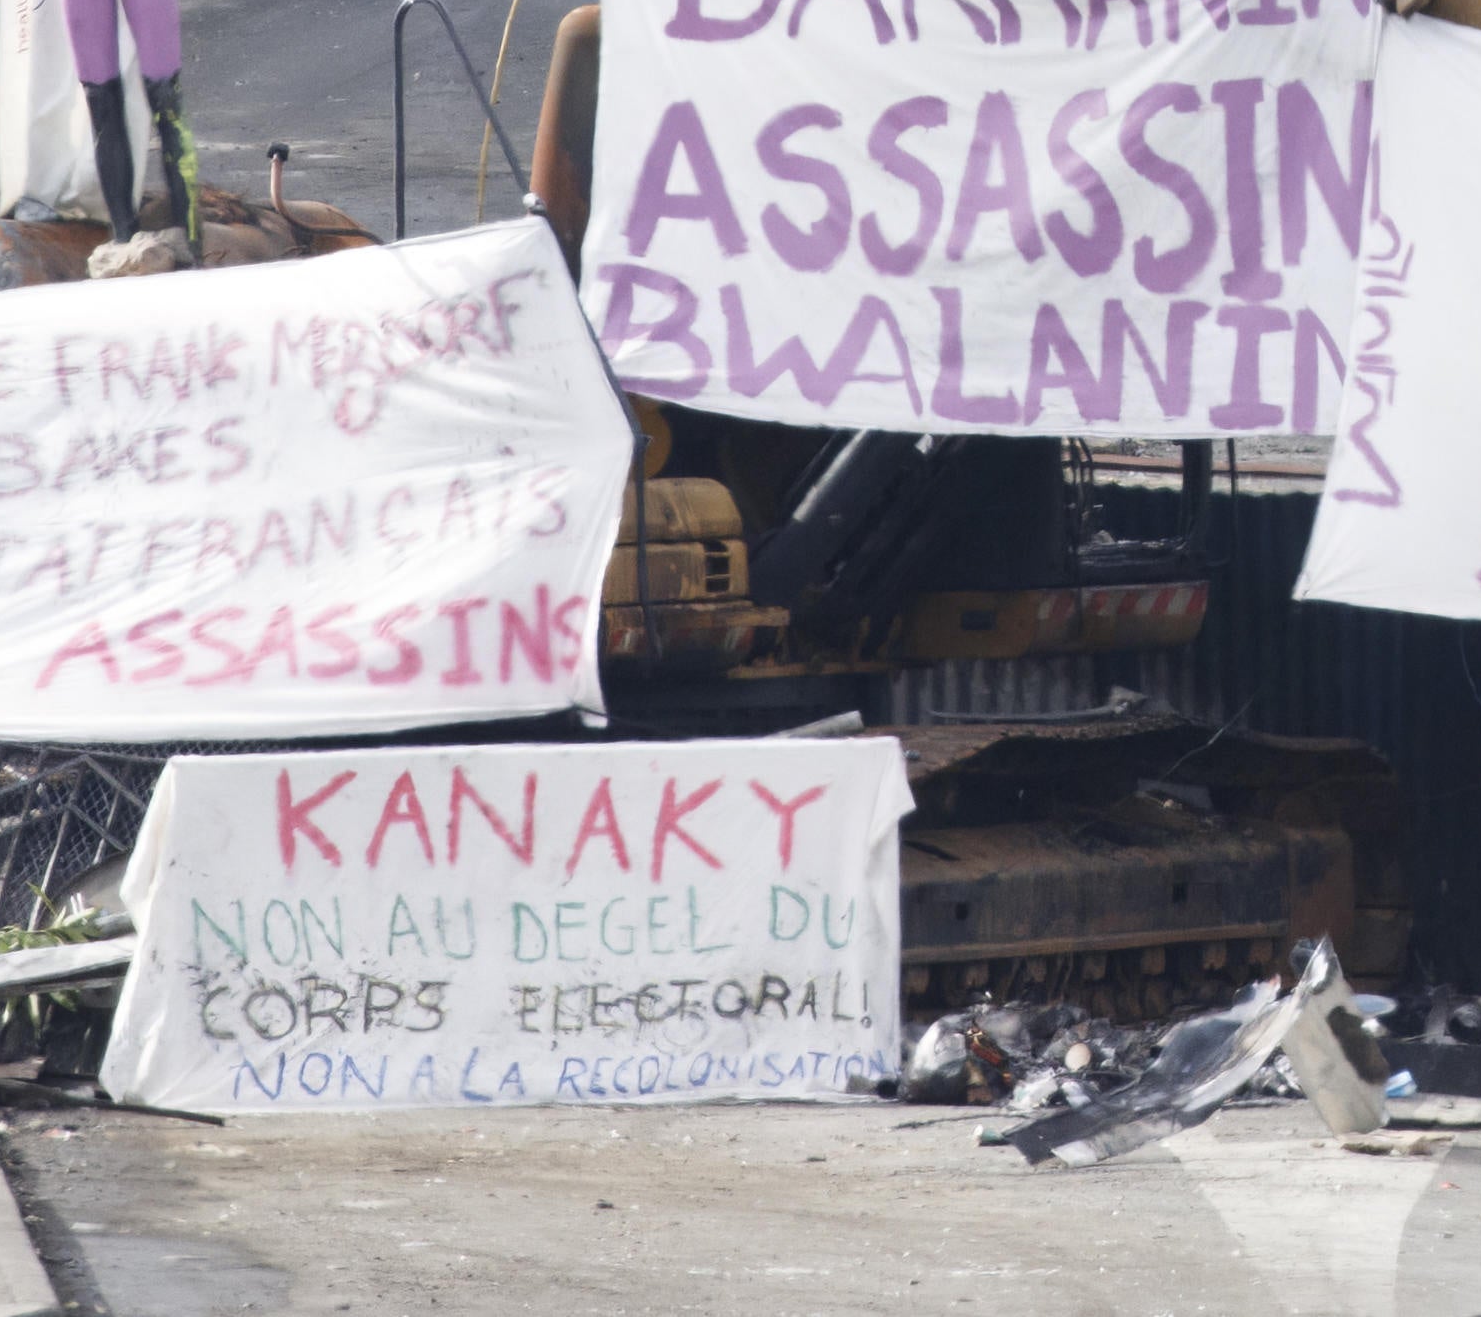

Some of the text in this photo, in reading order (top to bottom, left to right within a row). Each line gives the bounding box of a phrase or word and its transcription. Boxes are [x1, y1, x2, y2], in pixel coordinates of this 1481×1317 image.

[623, 77, 1374, 302] ASSASSIN
[35, 582, 587, 690] ASSASSINS
[274, 765, 829, 883] KANAKY
[192, 884, 856, 969] NON AU DEGEL DU
[199, 973, 450, 1041] CORPS
[233, 1046, 388, 1103] NON
[460, 1046, 526, 1103] LA
